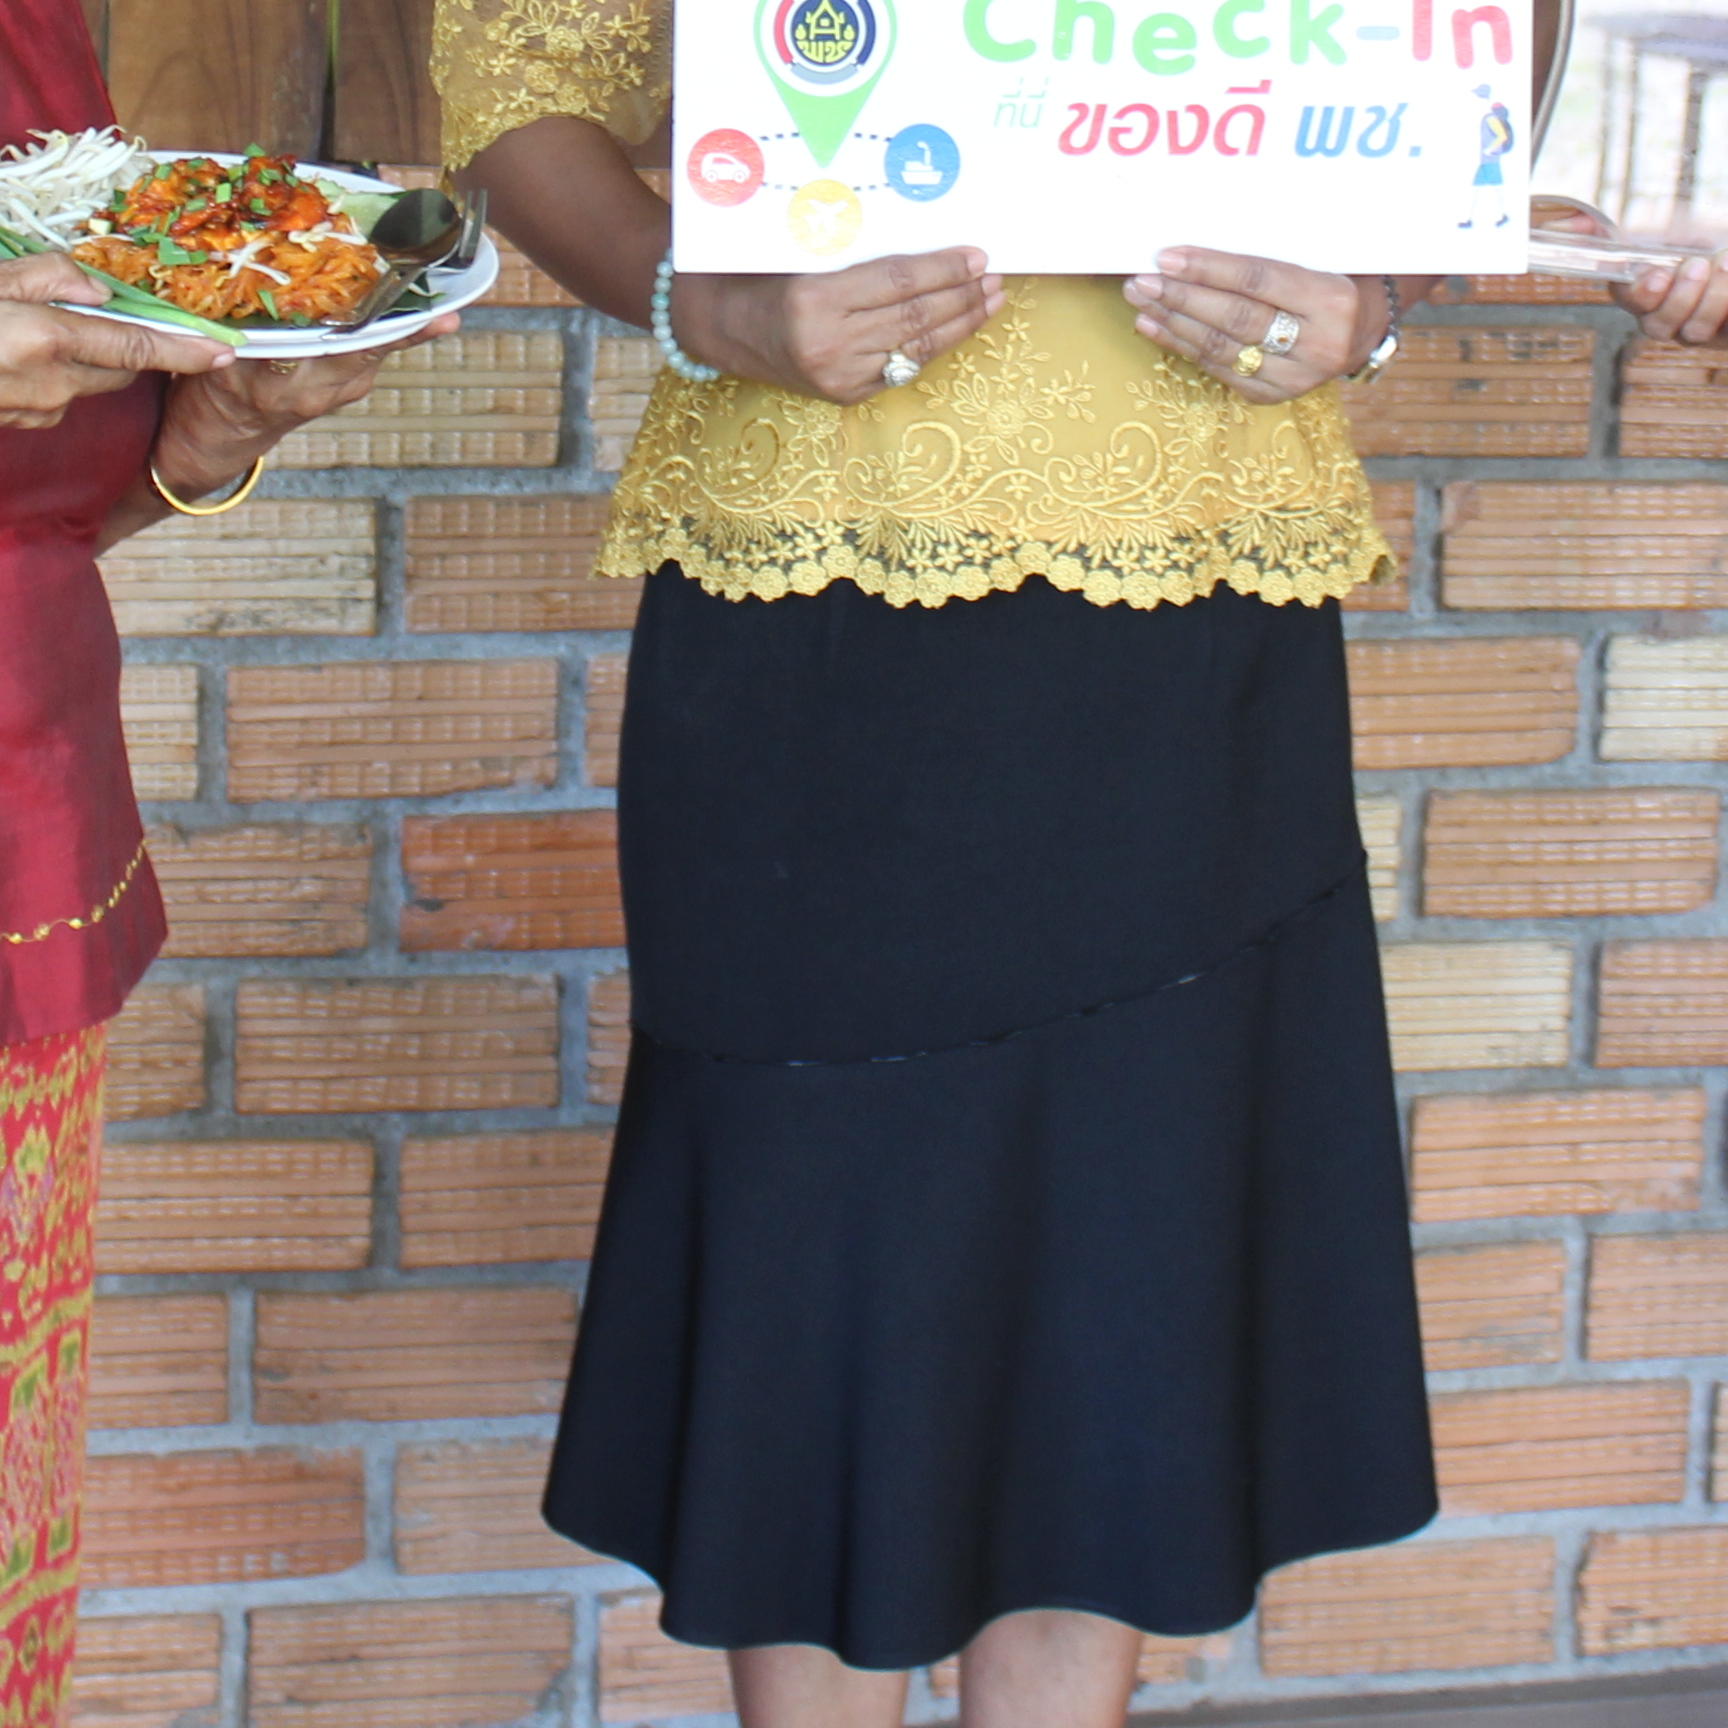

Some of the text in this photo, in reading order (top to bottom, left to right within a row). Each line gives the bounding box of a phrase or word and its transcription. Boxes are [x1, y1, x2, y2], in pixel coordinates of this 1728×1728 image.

[992, 77, 1422, 159] ที่นี่ ของดี พช.
